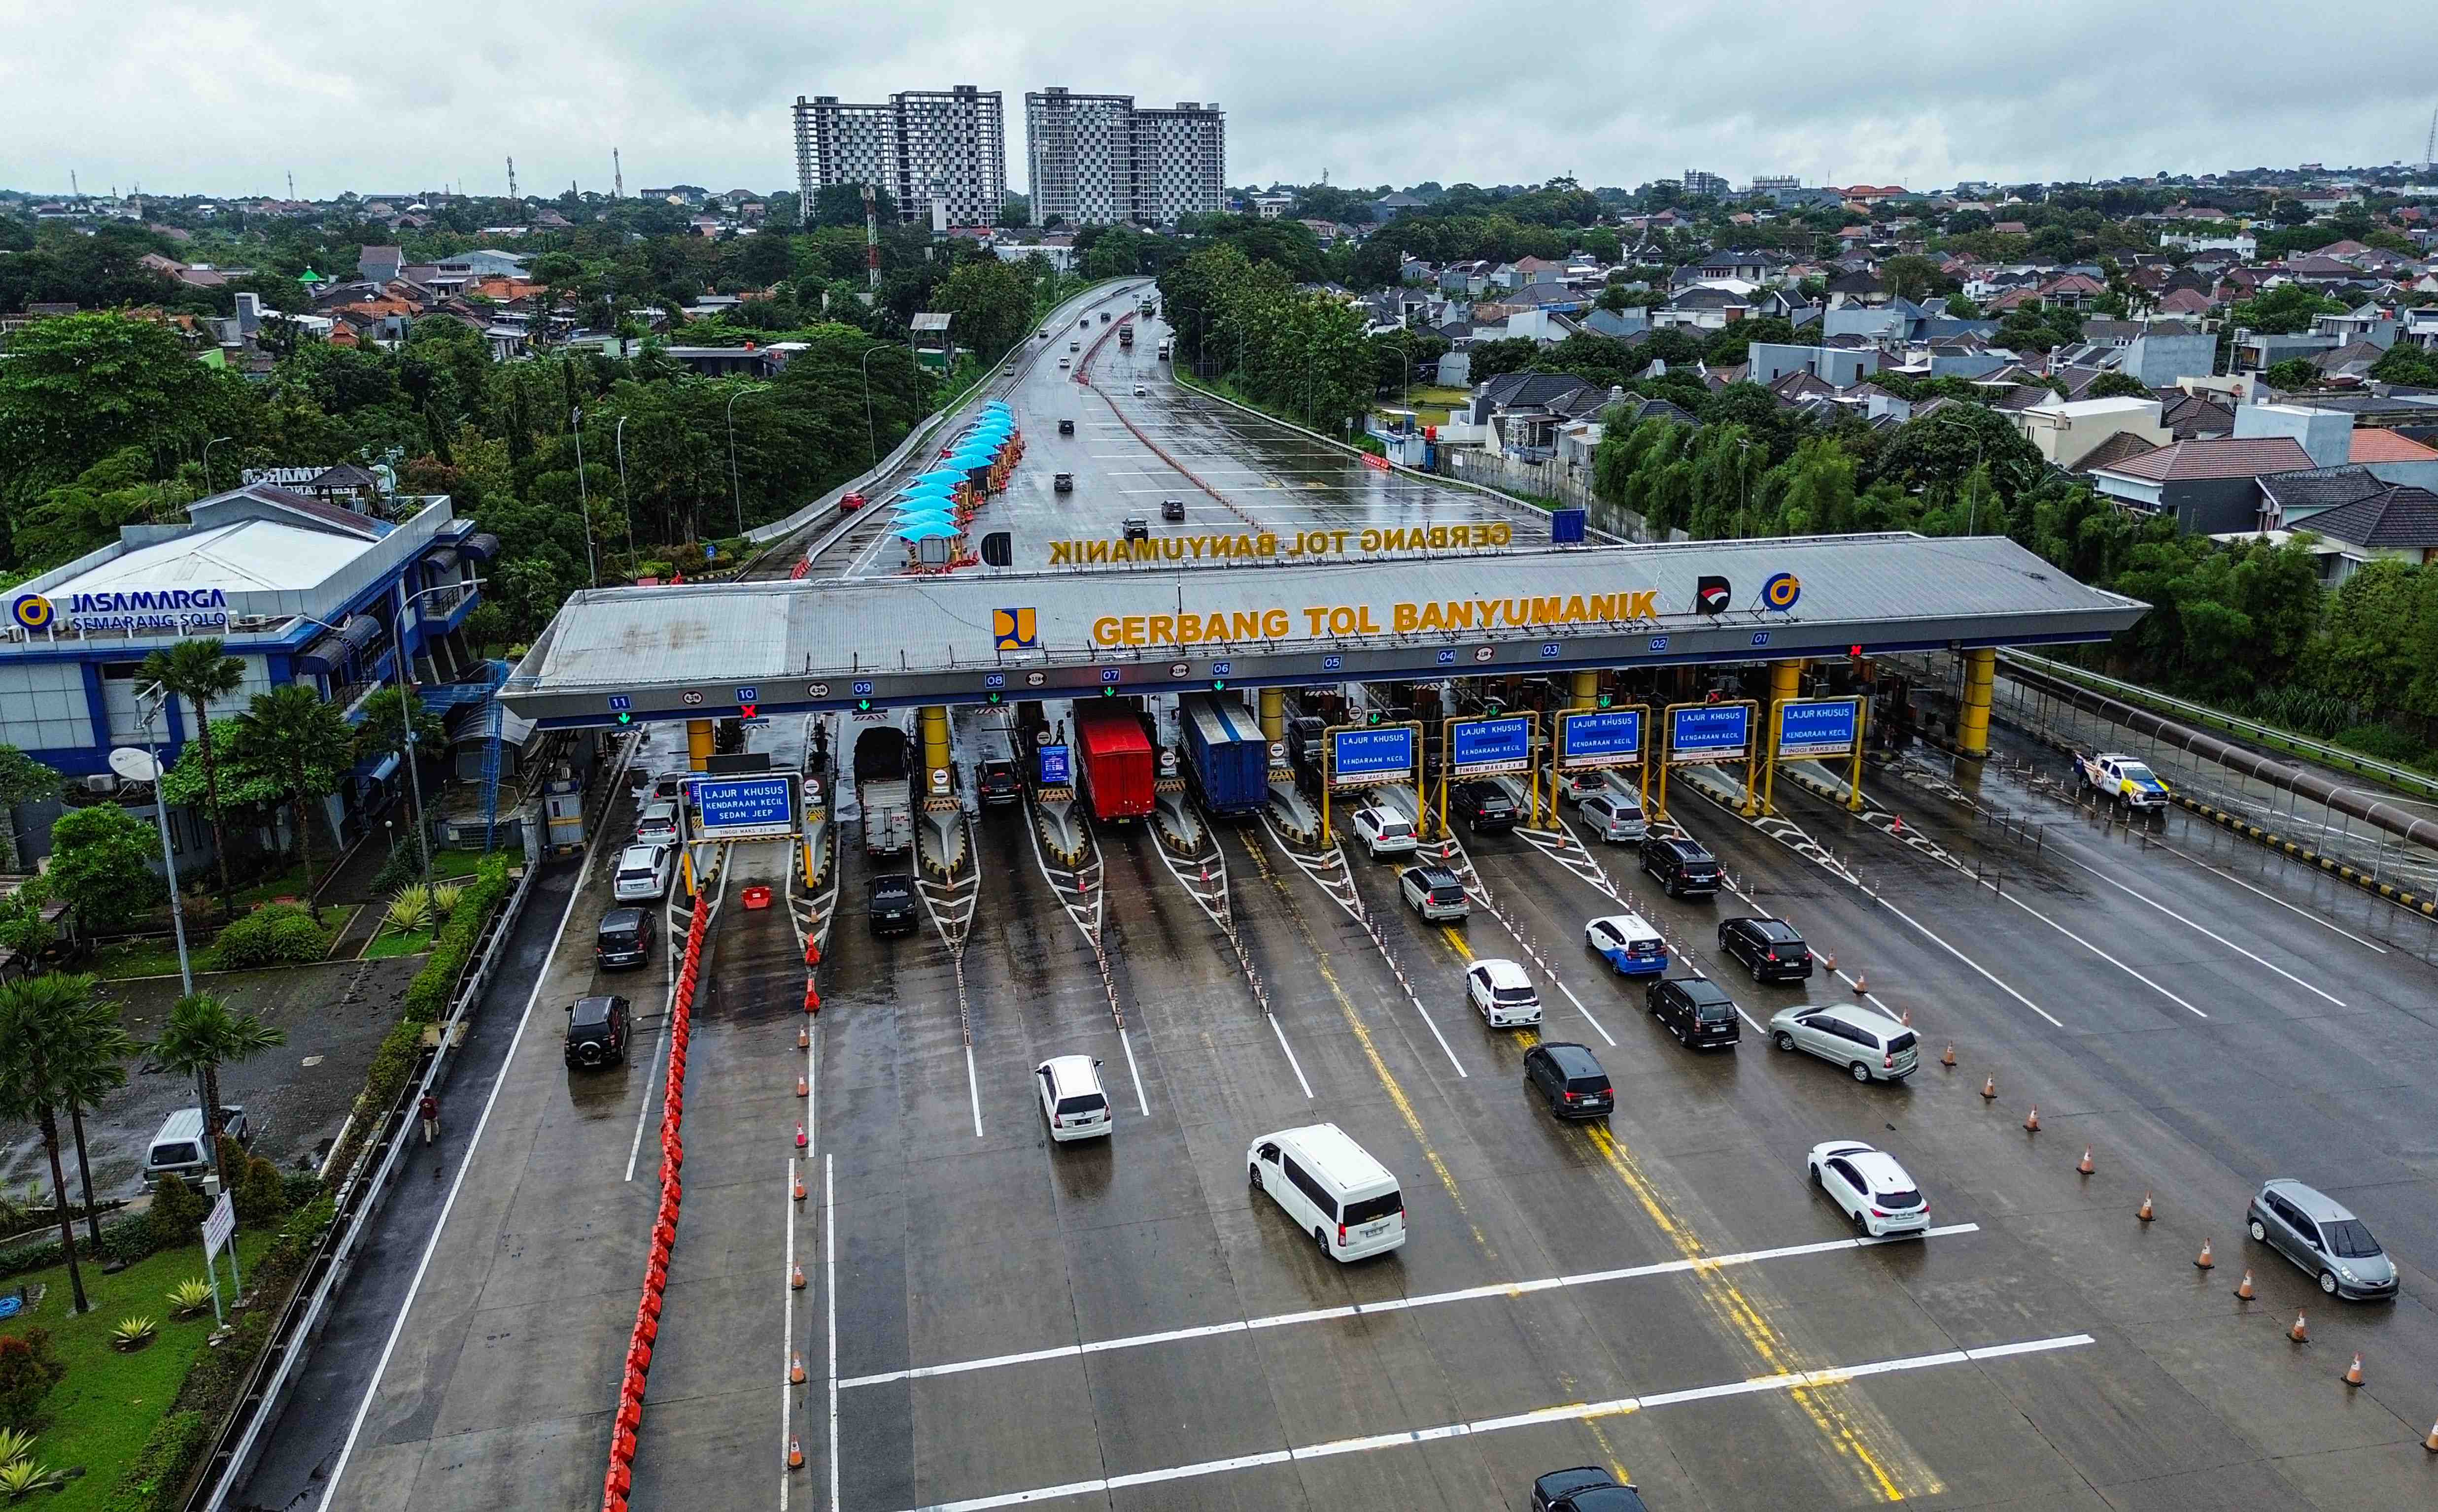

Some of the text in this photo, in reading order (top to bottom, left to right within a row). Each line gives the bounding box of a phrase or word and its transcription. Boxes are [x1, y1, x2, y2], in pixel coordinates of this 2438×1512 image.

[70, 589, 227, 613] JASAMARGA
[1093, 590, 1659, 645] GERBANG TOL BANYUMANIK
[1755, 634, 1767, 643] 01
[1652, 640, 1666, 648] 02
[1543, 645, 1558, 655] 03
[1439, 652, 1454, 661] 04
[1325, 658, 1339, 667] 05
[1103, 671, 1118, 679] 07
[987, 676, 1002, 685] 08
[740, 690, 753, 699] 10
[1682, 714, 1706, 722] LAJUR
[1787, 708, 1850, 719] LAJUR KHUSUS
[1573, 717, 1632, 729] LAJUR KHUSUS
[1461, 724, 1522, 736] LAJUR KHUSUS
[1374, 735, 1404, 743] KHUSUS
[1462, 747, 1500, 755] KENDARAAN
[705, 789, 737, 799] LAJUR
[744, 786, 784, 796] KHUSUS
[706, 800, 756, 809] KENDARAAN
[752, 809, 773, 817] JEEP
